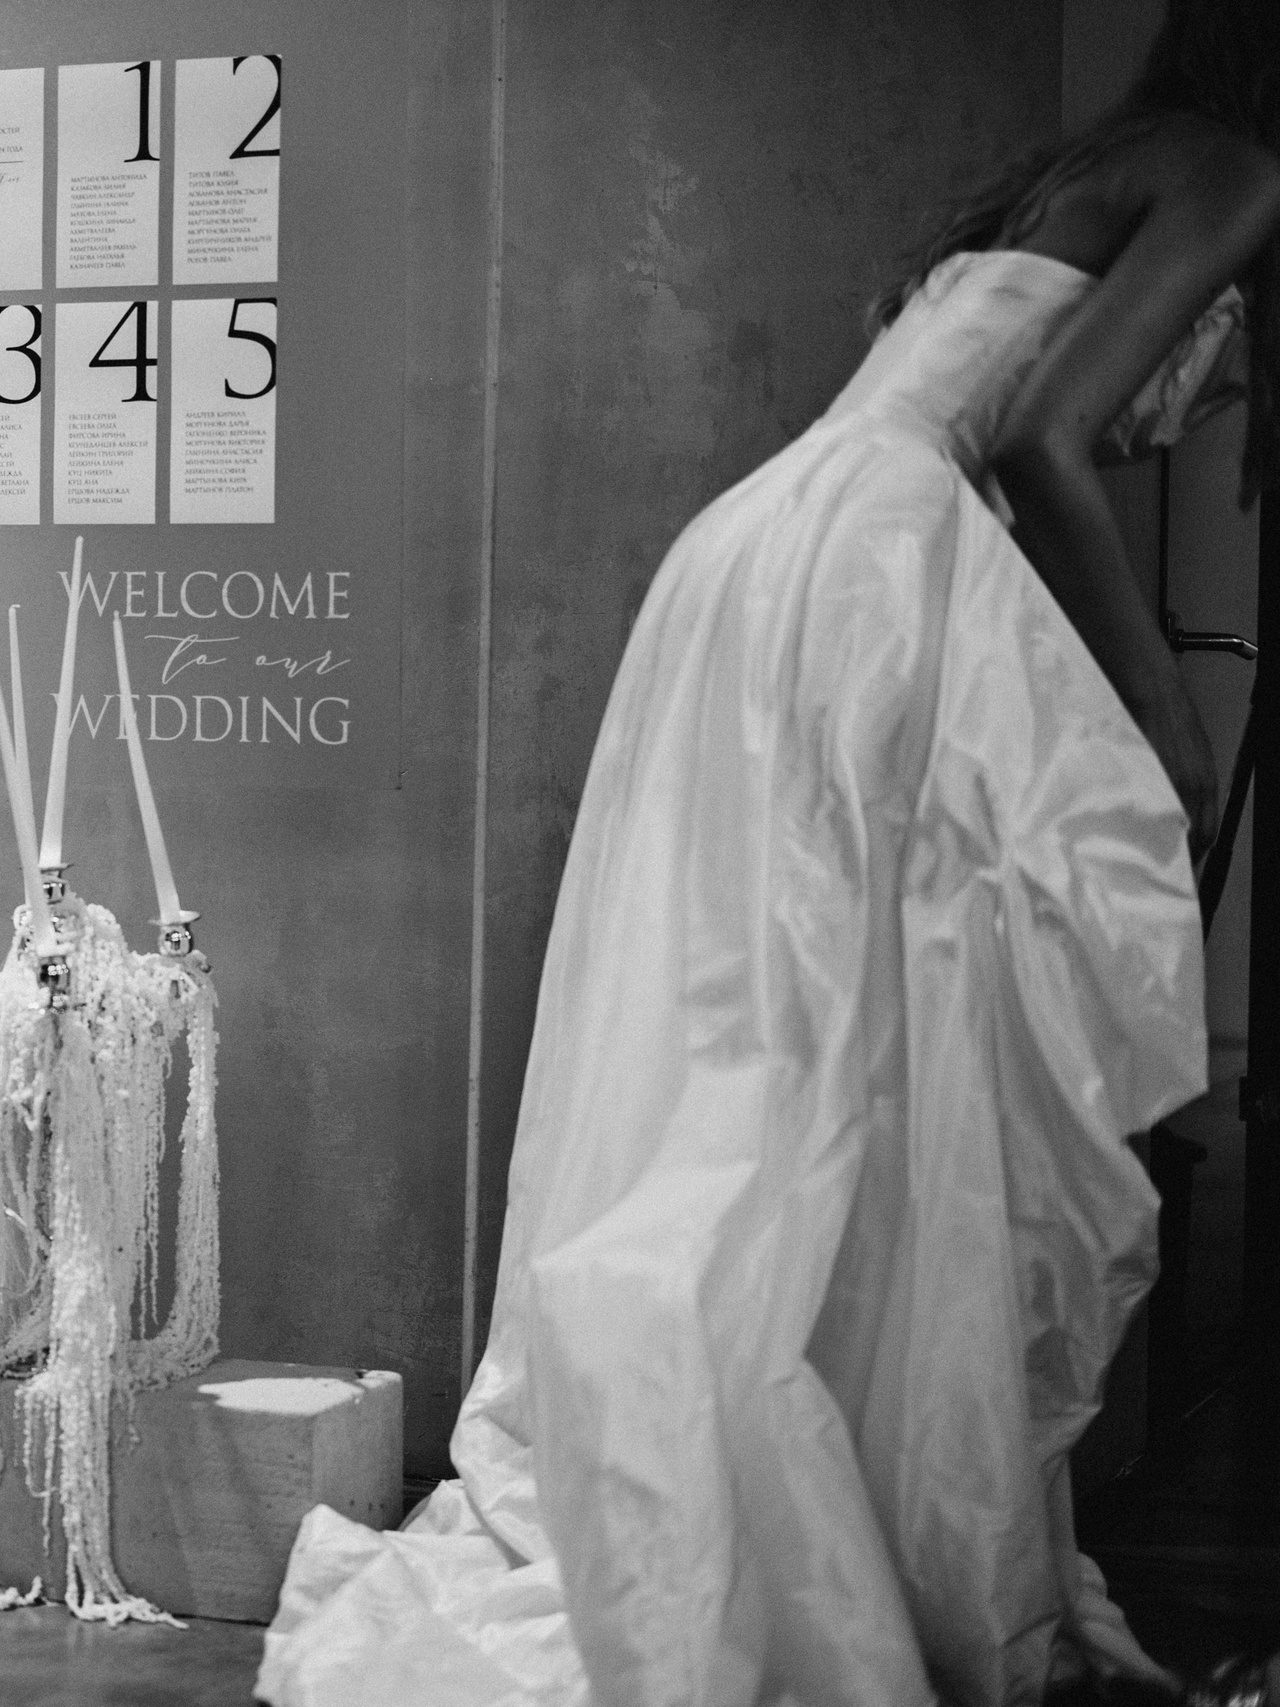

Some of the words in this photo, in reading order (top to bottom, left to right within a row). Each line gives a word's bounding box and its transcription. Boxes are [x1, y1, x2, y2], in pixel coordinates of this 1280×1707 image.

[124, 61, 160, 163] 1
[229, 55, 282, 159] 2
[89, 302, 157, 402] 4
[225, 298, 277, 399] 5
[57, 571, 350, 619] WELCOME
[144, 634, 239, 684] to
[255, 650, 351, 678] our
